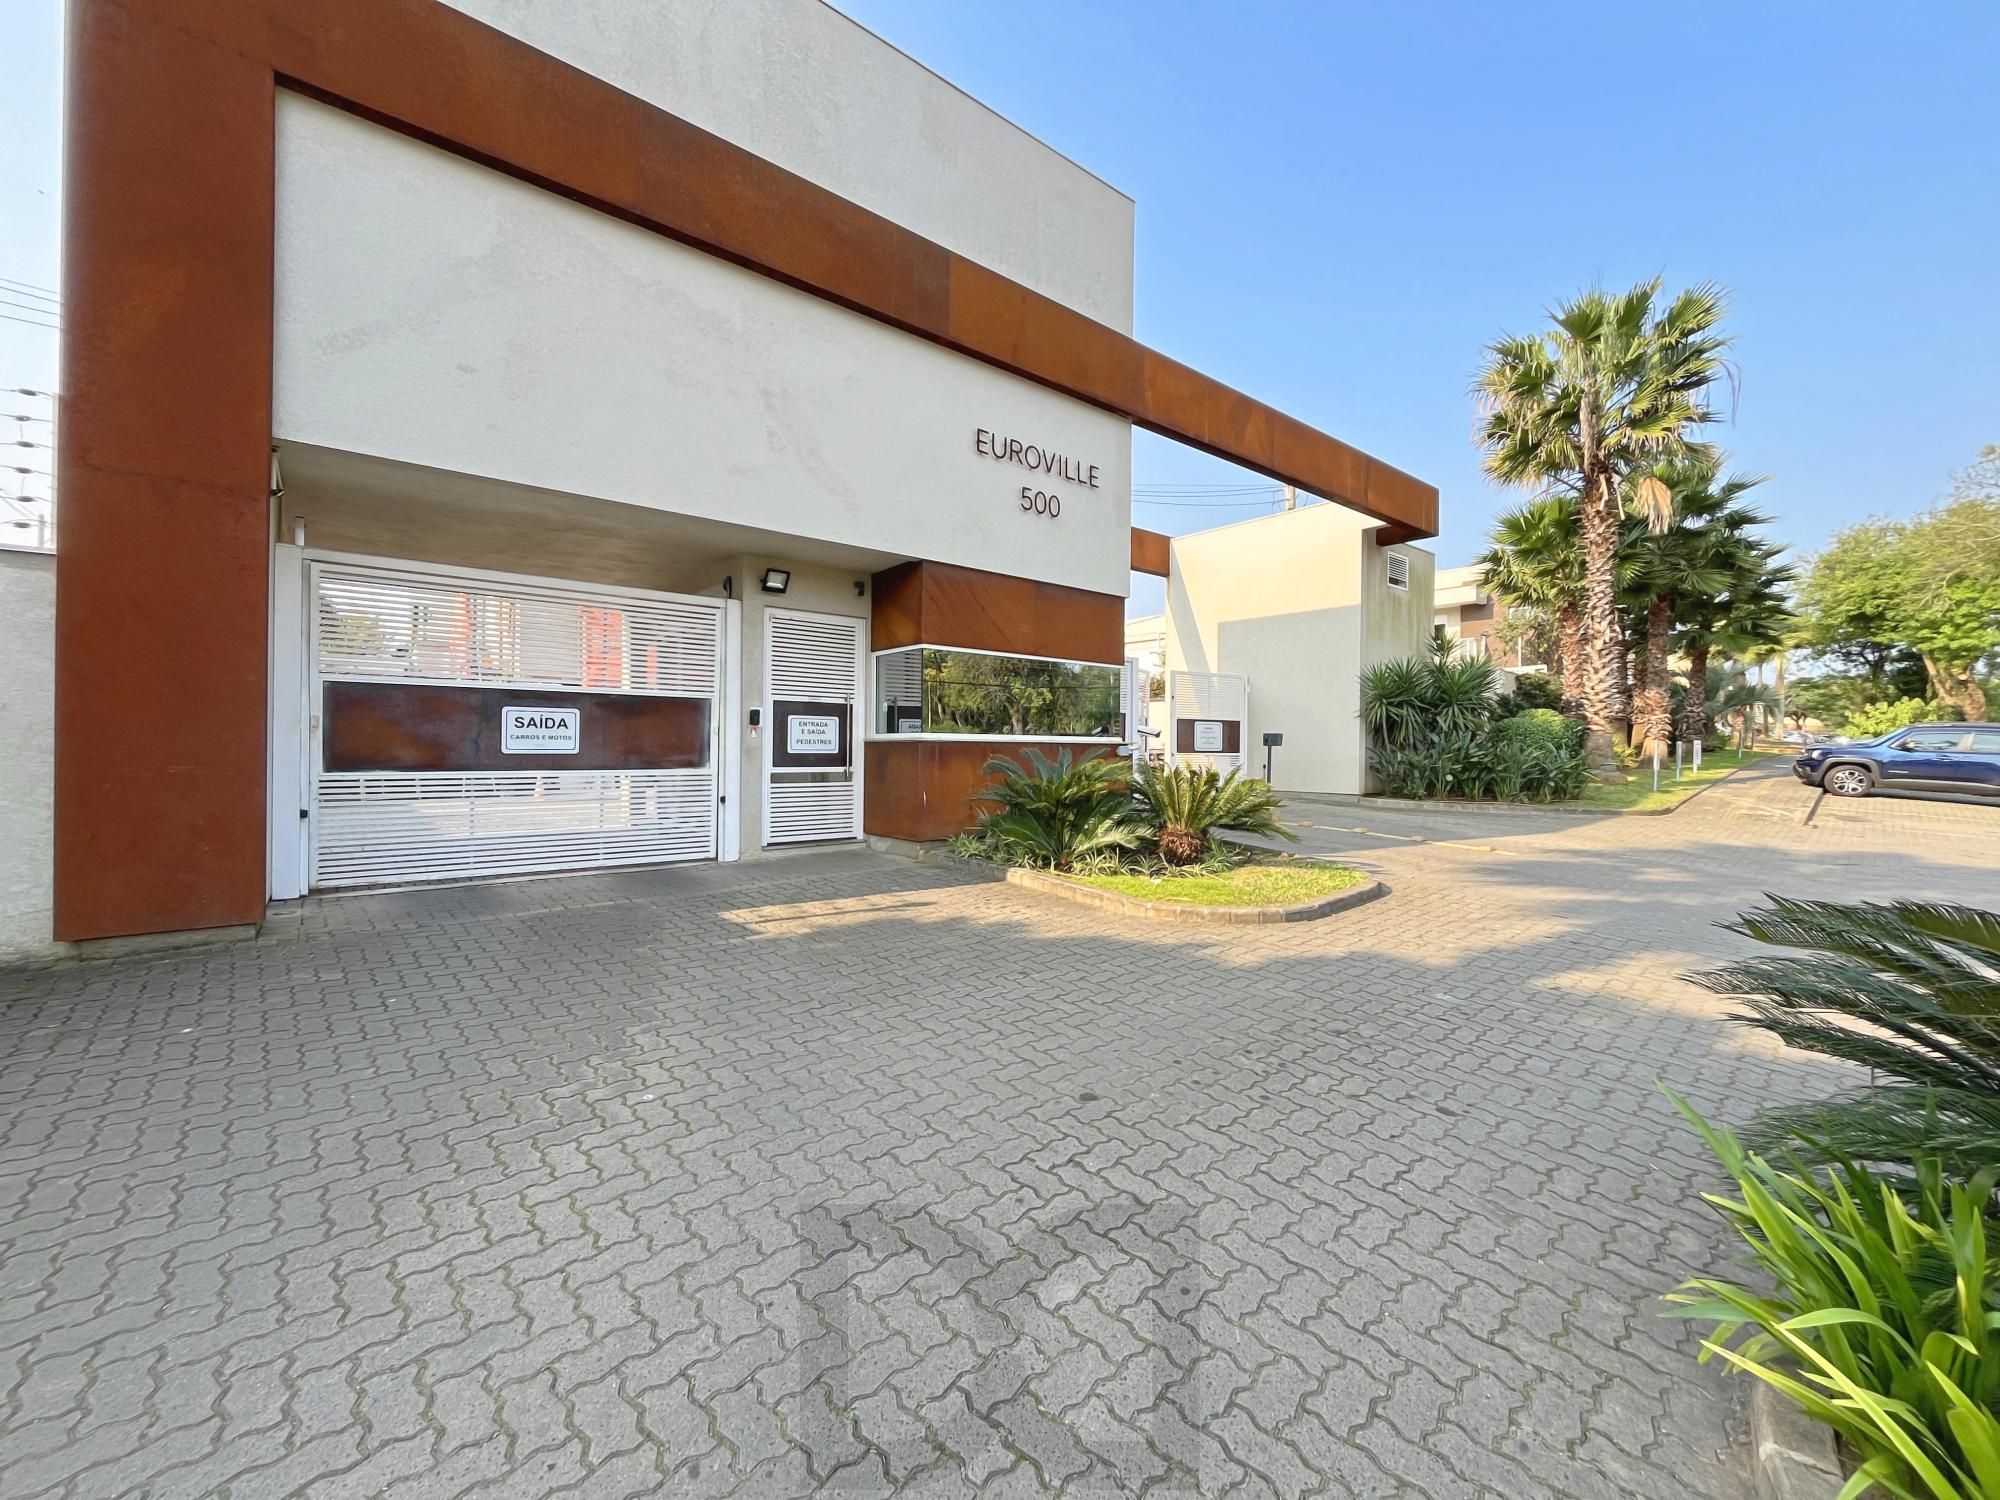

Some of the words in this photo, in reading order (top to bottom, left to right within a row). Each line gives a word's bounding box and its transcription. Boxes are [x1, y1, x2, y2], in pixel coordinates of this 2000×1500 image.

[976, 428, 1100, 489] EUROVILLE
[1020, 486, 1061, 518] 500
[514, 714, 569, 730] SAÍDA
[798, 720, 829, 728] ENTRADA
